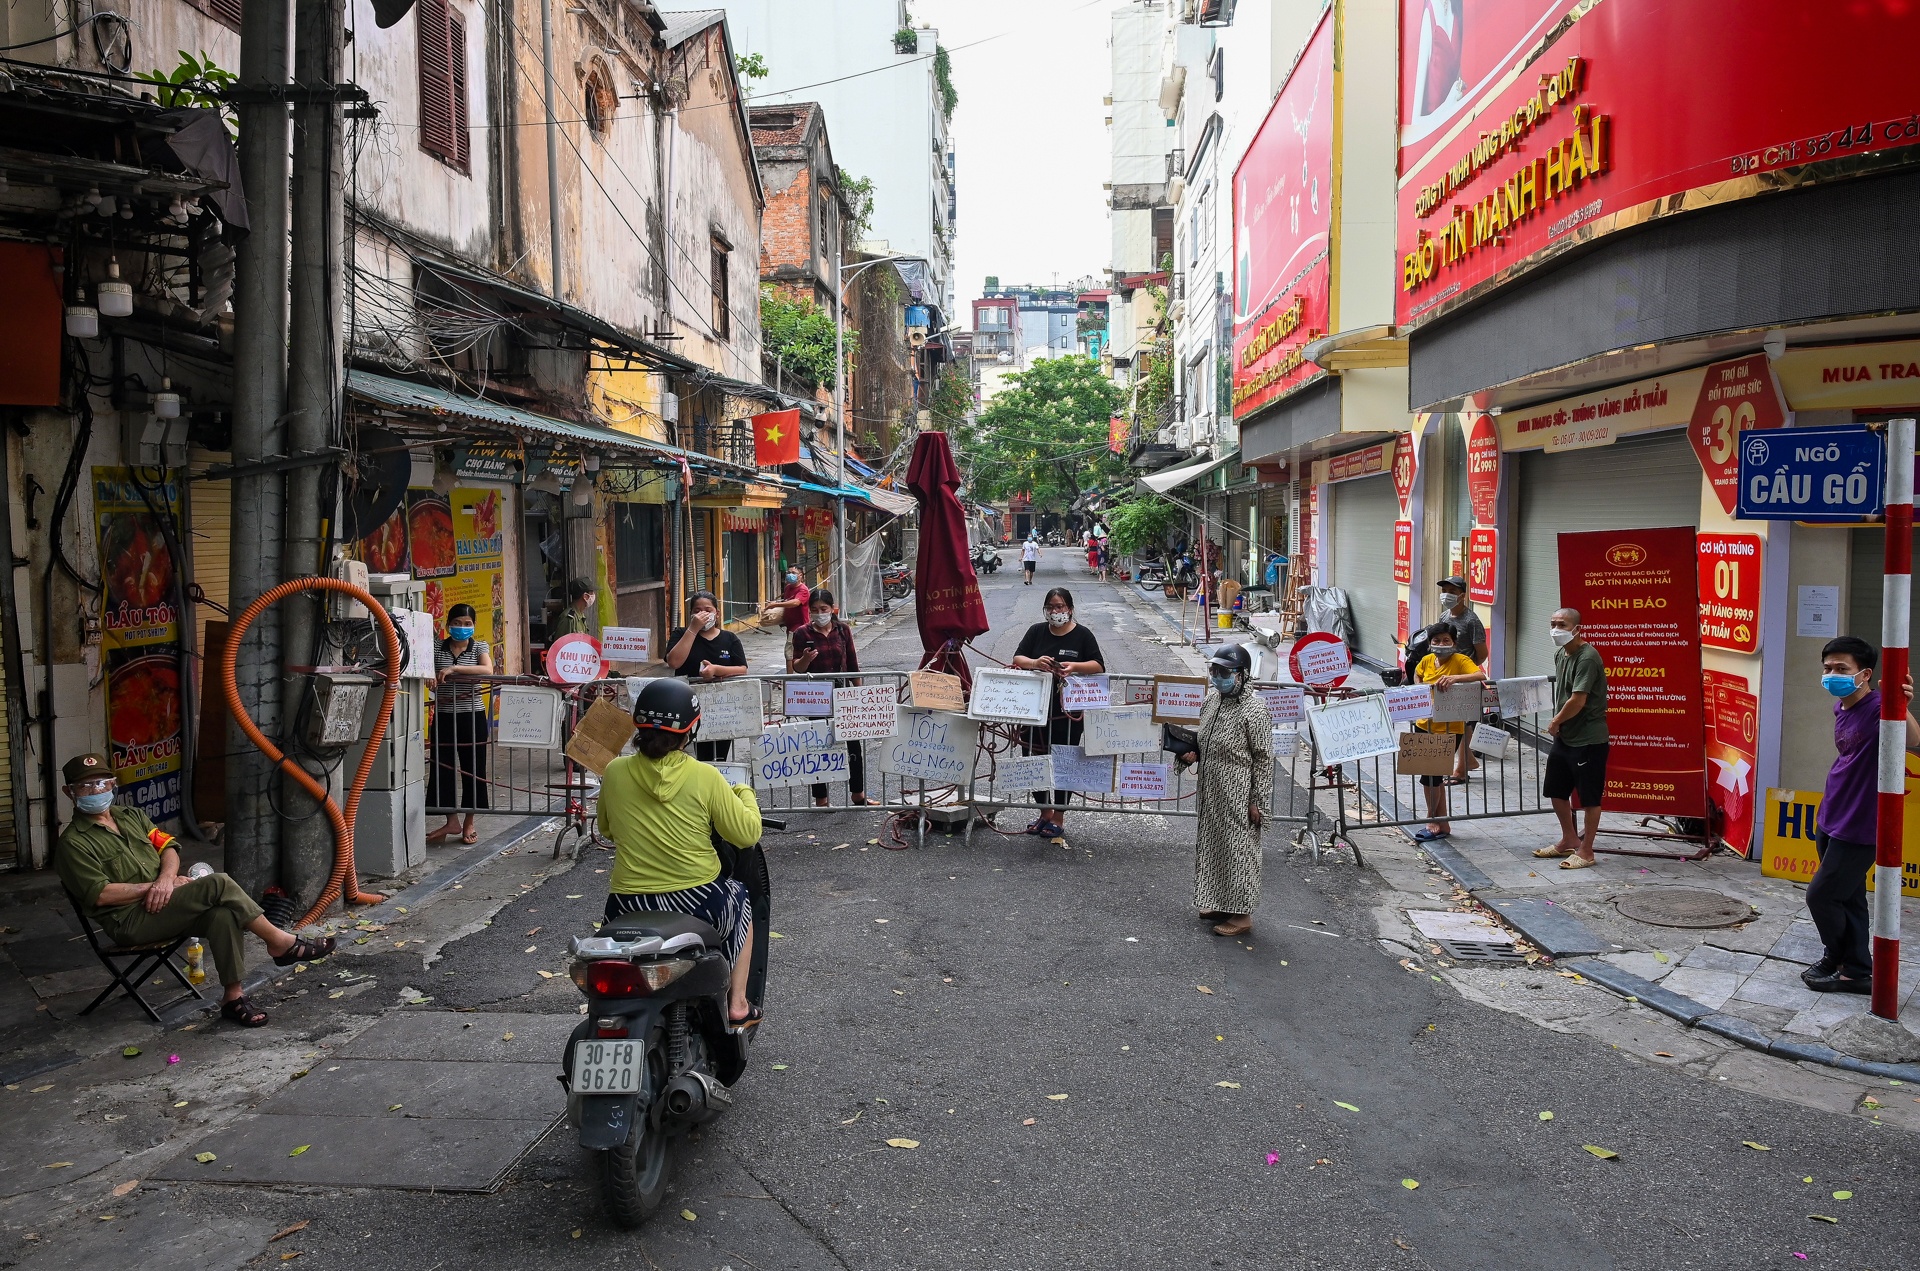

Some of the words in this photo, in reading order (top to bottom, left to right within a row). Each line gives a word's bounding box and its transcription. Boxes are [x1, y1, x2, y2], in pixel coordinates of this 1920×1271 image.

[1415, 186, 1437, 218] CÔNG
[1438, 173, 1446, 199] TY
[1449, 145, 1469, 190] TNHH
[1472, 129, 1500, 170] VÀNG
[1500, 104, 1523, 148] BẠC
[1526, 72, 1544, 123] ĐÁ
[1548, 54, 1578, 103] QUÝ
[1731, 155, 1759, 174] Địa
[1763, 142, 1800, 165] Chỉ:
[1806, 132, 1834, 156] Số
[1837, 122, 1873, 148] 44
[1403, 229, 1434, 292] BẢO
[1439, 206, 1467, 267] TÍN
[1473, 157, 1536, 247] MẠNH
[1546, 102, 1600, 200] HẢI
[1721, 368, 1735, 383] TRỢ
[1737, 362, 1749, 378] GIÁ
[1823, 366, 1871, 383] MUA
[1708, 386, 1721, 401] ĐỔI
[1723, 384, 1746, 399] TRANG
[1747, 378, 1761, 394] SỨC
[1517, 420, 1530, 433] MUA
[1532, 415, 1552, 431] TRANG
[1553, 408, 1567, 426] SỨC
[1572, 402, 1595, 422] TRÚNG
[1598, 398, 1621, 418] VÀNG
[1703, 427, 1711, 436] UP
[1471, 439, 1477, 447] CƠ
[1484, 436, 1495, 446] TRÚNG
[1703, 437, 1711, 445] TO
[1488, 449, 1496, 457] VÀNG
[1795, 442, 1840, 462] NGÕ
[465, 459, 482, 469] CHỢ
[1470, 452, 1480, 473] 12
[1481, 460, 1496, 472] 999.9
[1750, 465, 1811, 504] CẦU
[1823, 461, 1871, 504] GỖ
[456, 534, 472, 556] HẢI
[474, 534, 488, 554] SẢN
[1399, 535, 1406, 556] 01
[1700, 542, 1712, 553] CƠ
[1714, 540, 1726, 557] HỘI
[1728, 541, 1754, 555] TRÚNG
[1585, 578, 1604, 586] BẢO
[1624, 578, 1652, 586] MẠNH
[1714, 560, 1738, 600] 01
[943, 586, 961, 598] TÍN
[1591, 597, 1629, 609] KÍNH
[1633, 595, 1667, 609] BÁO
[105, 600, 143, 630] LẨU
[146, 601, 180, 624] TÔM
[1699, 601, 1711, 616] CHỈ
[1712, 605, 1733, 619] VÀNG
[1734, 610, 1753, 622] 999.9
[124, 631, 135, 640] HOT
[137, 629, 146, 638] POT
[148, 627, 167, 638] SHRIMP
[1712, 621, 1730, 639] TUẦN
[560, 651, 578, 661] KHU
[581, 654, 597, 664] VỰC
[562, 662, 592, 676] CẤM
[837, 690, 858, 699] MAI:
[860, 687, 874, 696] CÁ
[861, 696, 874, 704] CÁ
[1615, 693, 1635, 701] ĐỘNG
[841, 705, 860, 713] THỊT:
[841, 729, 890, 738] 0396011443
[908, 712, 948, 744] TÔM
[757, 731, 799, 760] BÚN
[801, 727, 835, 749] Phở
[113, 738, 148, 769] LẨU
[152, 737, 181, 759] CUA
[136, 769, 146, 778] HOT
[156, 762, 168, 773] CRAB
[762, 753, 846, 780] 0965152391
[137, 780, 166, 804] CẦU
[1608, 781, 1624, 789] 024
[1630, 782, 1651, 790] 2233
[1653, 783, 1675, 791] 9999
[1608, 791, 1675, 802] baotinmanhhai.vn
[1774, 856, 1797, 873] 096
[1802, 859, 1817, 875] 22
[584, 1044, 633, 1065] 30-F8
[582, 1068, 631, 1090] 9620
